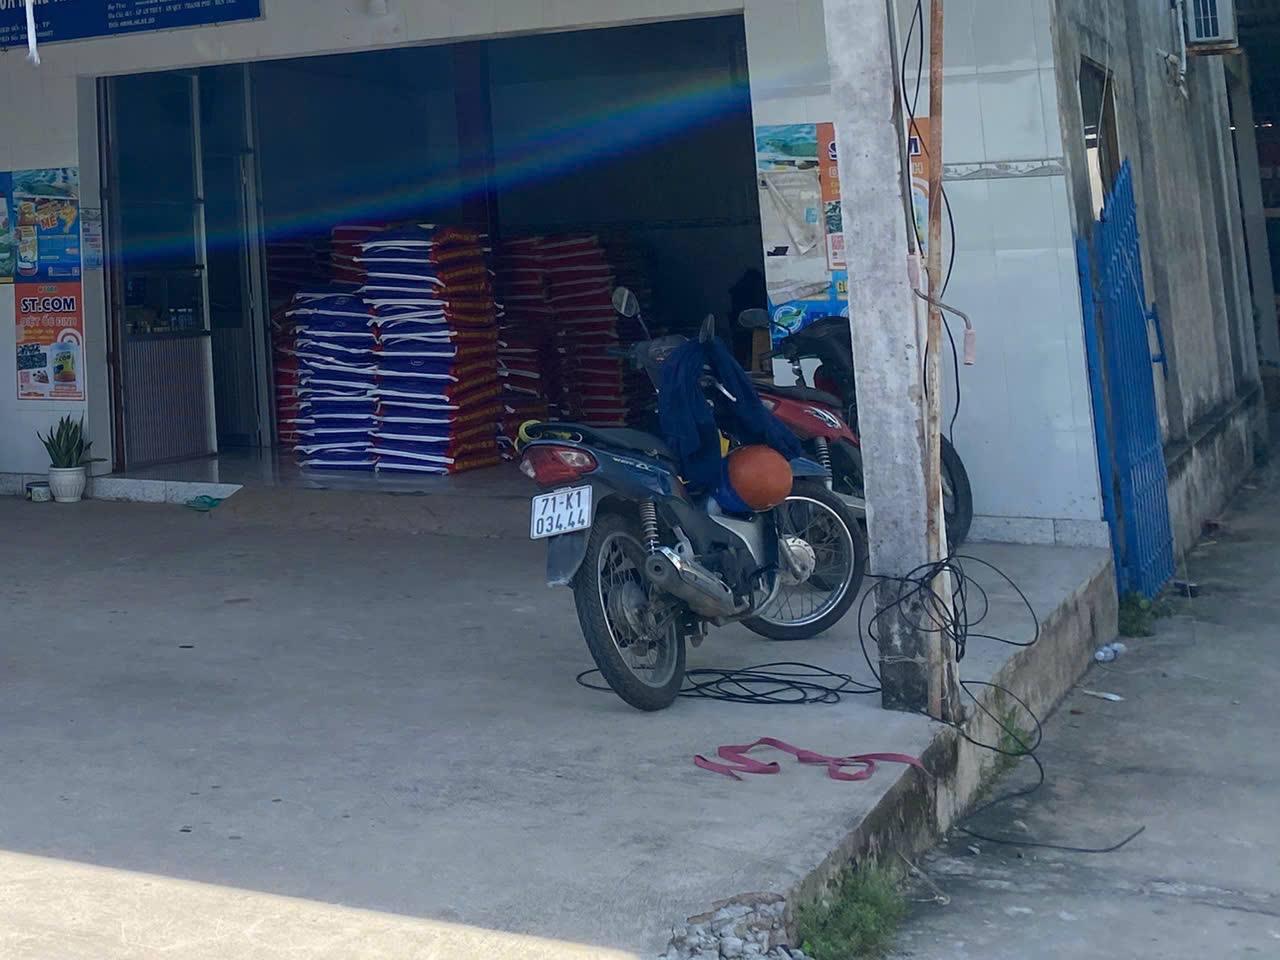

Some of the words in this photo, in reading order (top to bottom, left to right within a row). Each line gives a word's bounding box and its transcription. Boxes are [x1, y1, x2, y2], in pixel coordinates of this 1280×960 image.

[22, 296, 76, 313] ST.COM
[541, 490, 582, 516] 71-K1
[535, 509, 586, 535] 034.44
